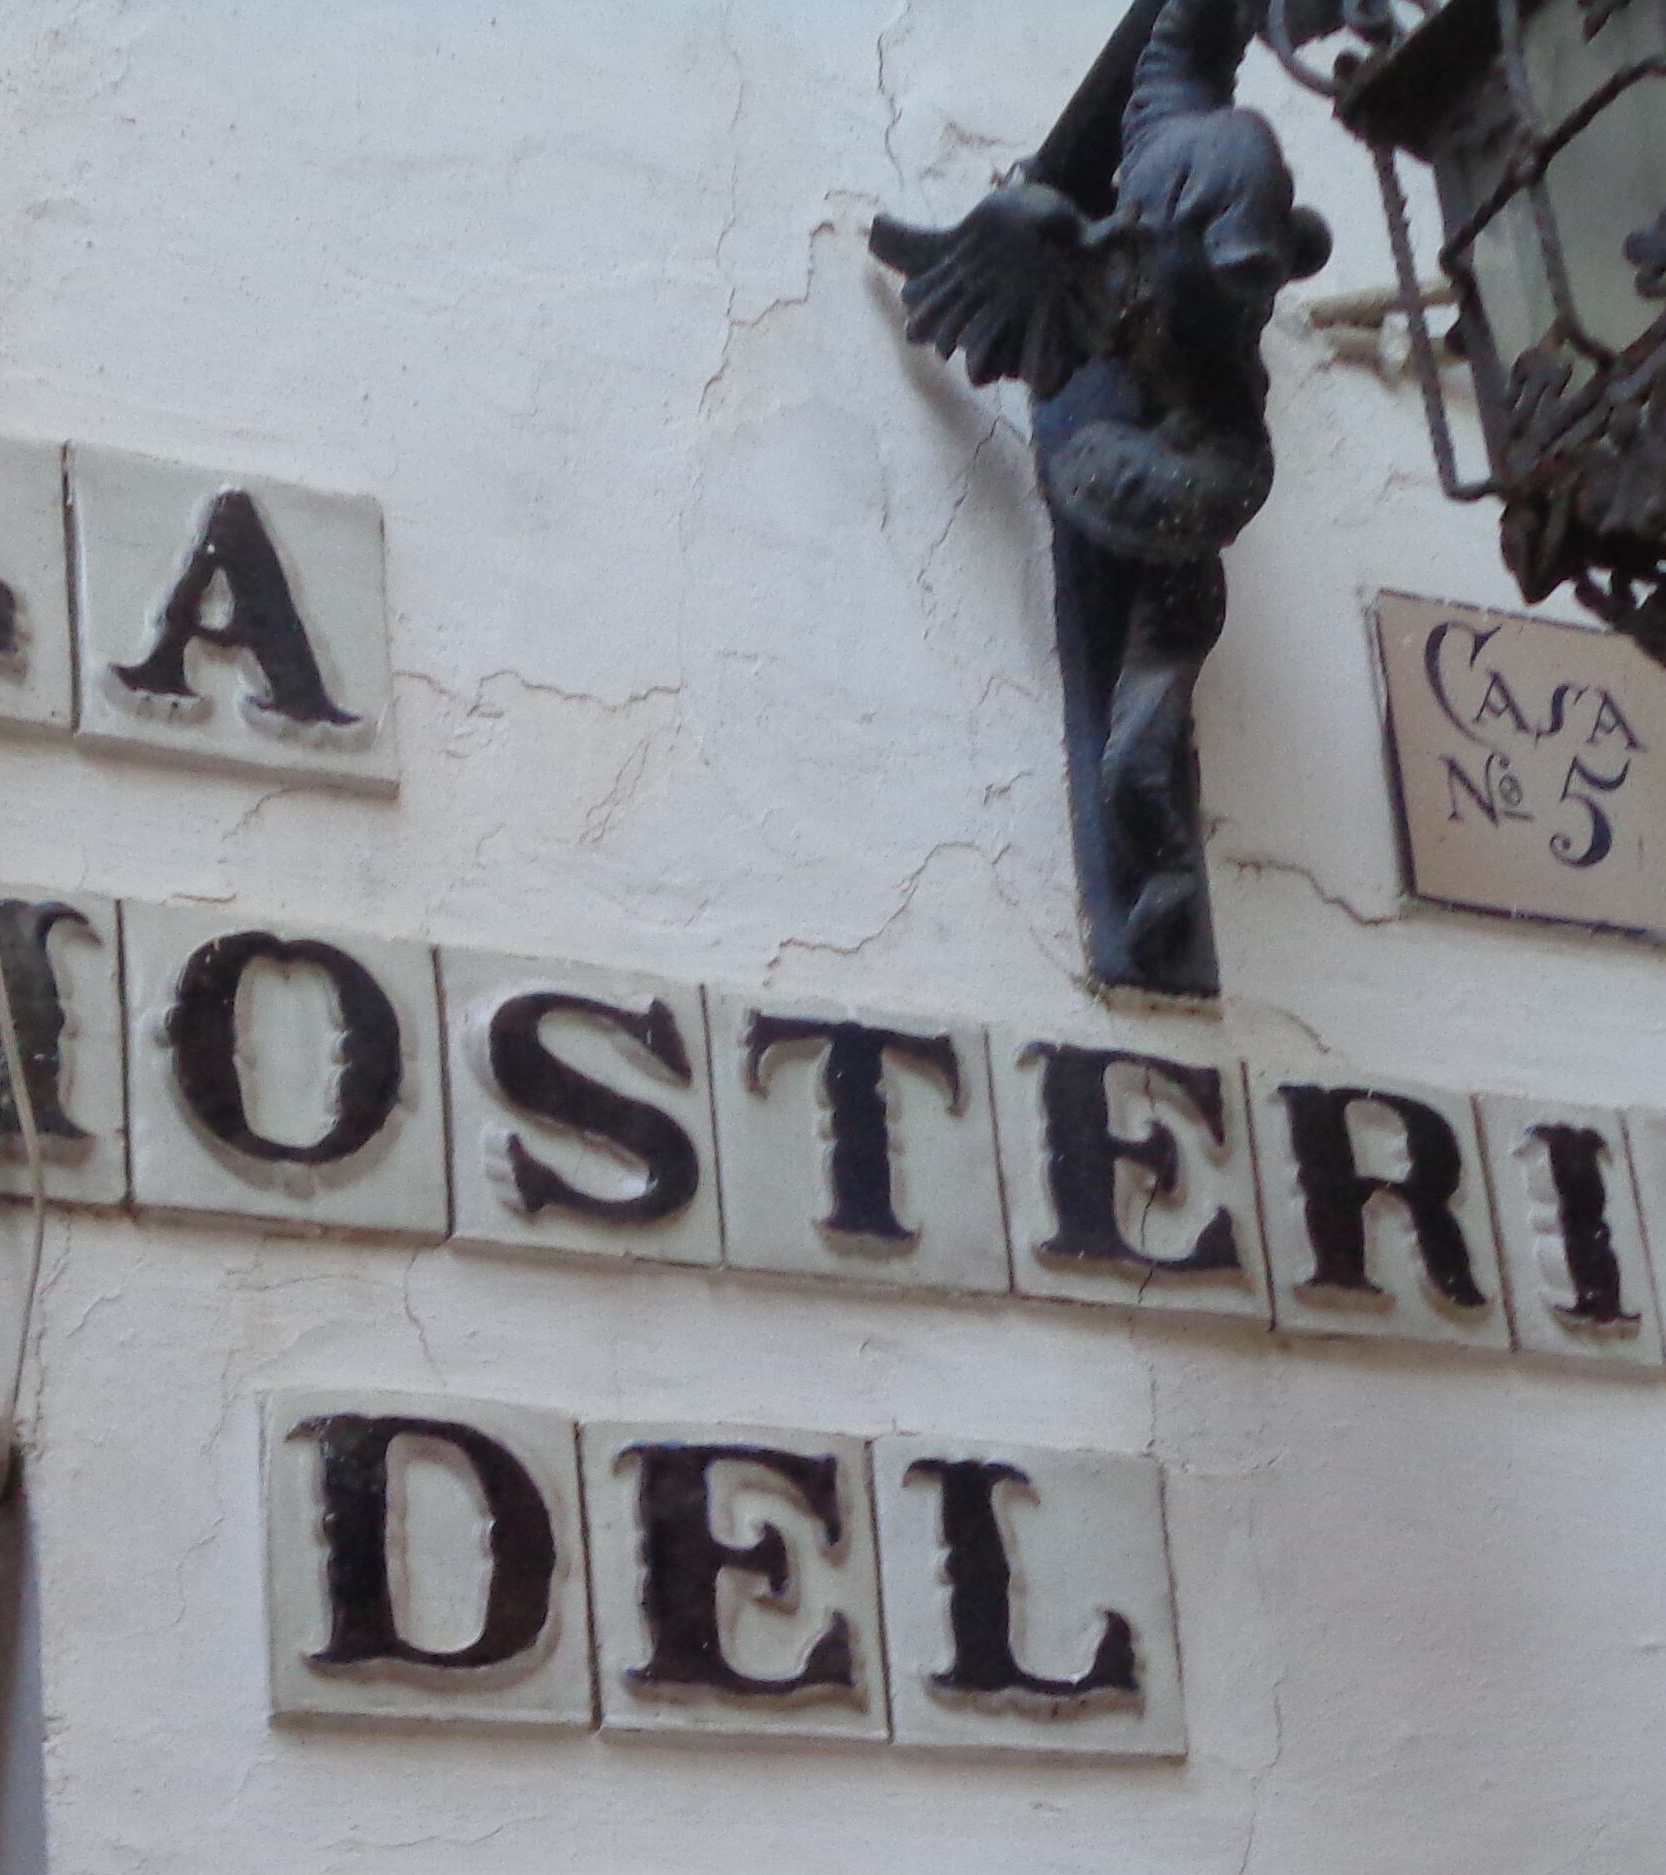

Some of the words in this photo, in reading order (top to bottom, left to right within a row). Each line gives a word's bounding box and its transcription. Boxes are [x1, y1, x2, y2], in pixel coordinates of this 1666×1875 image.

[1424, 622, 1644, 753] CASA
[1549, 755, 1631, 869] 5
[286, 1412, 1140, 1696] DEL
